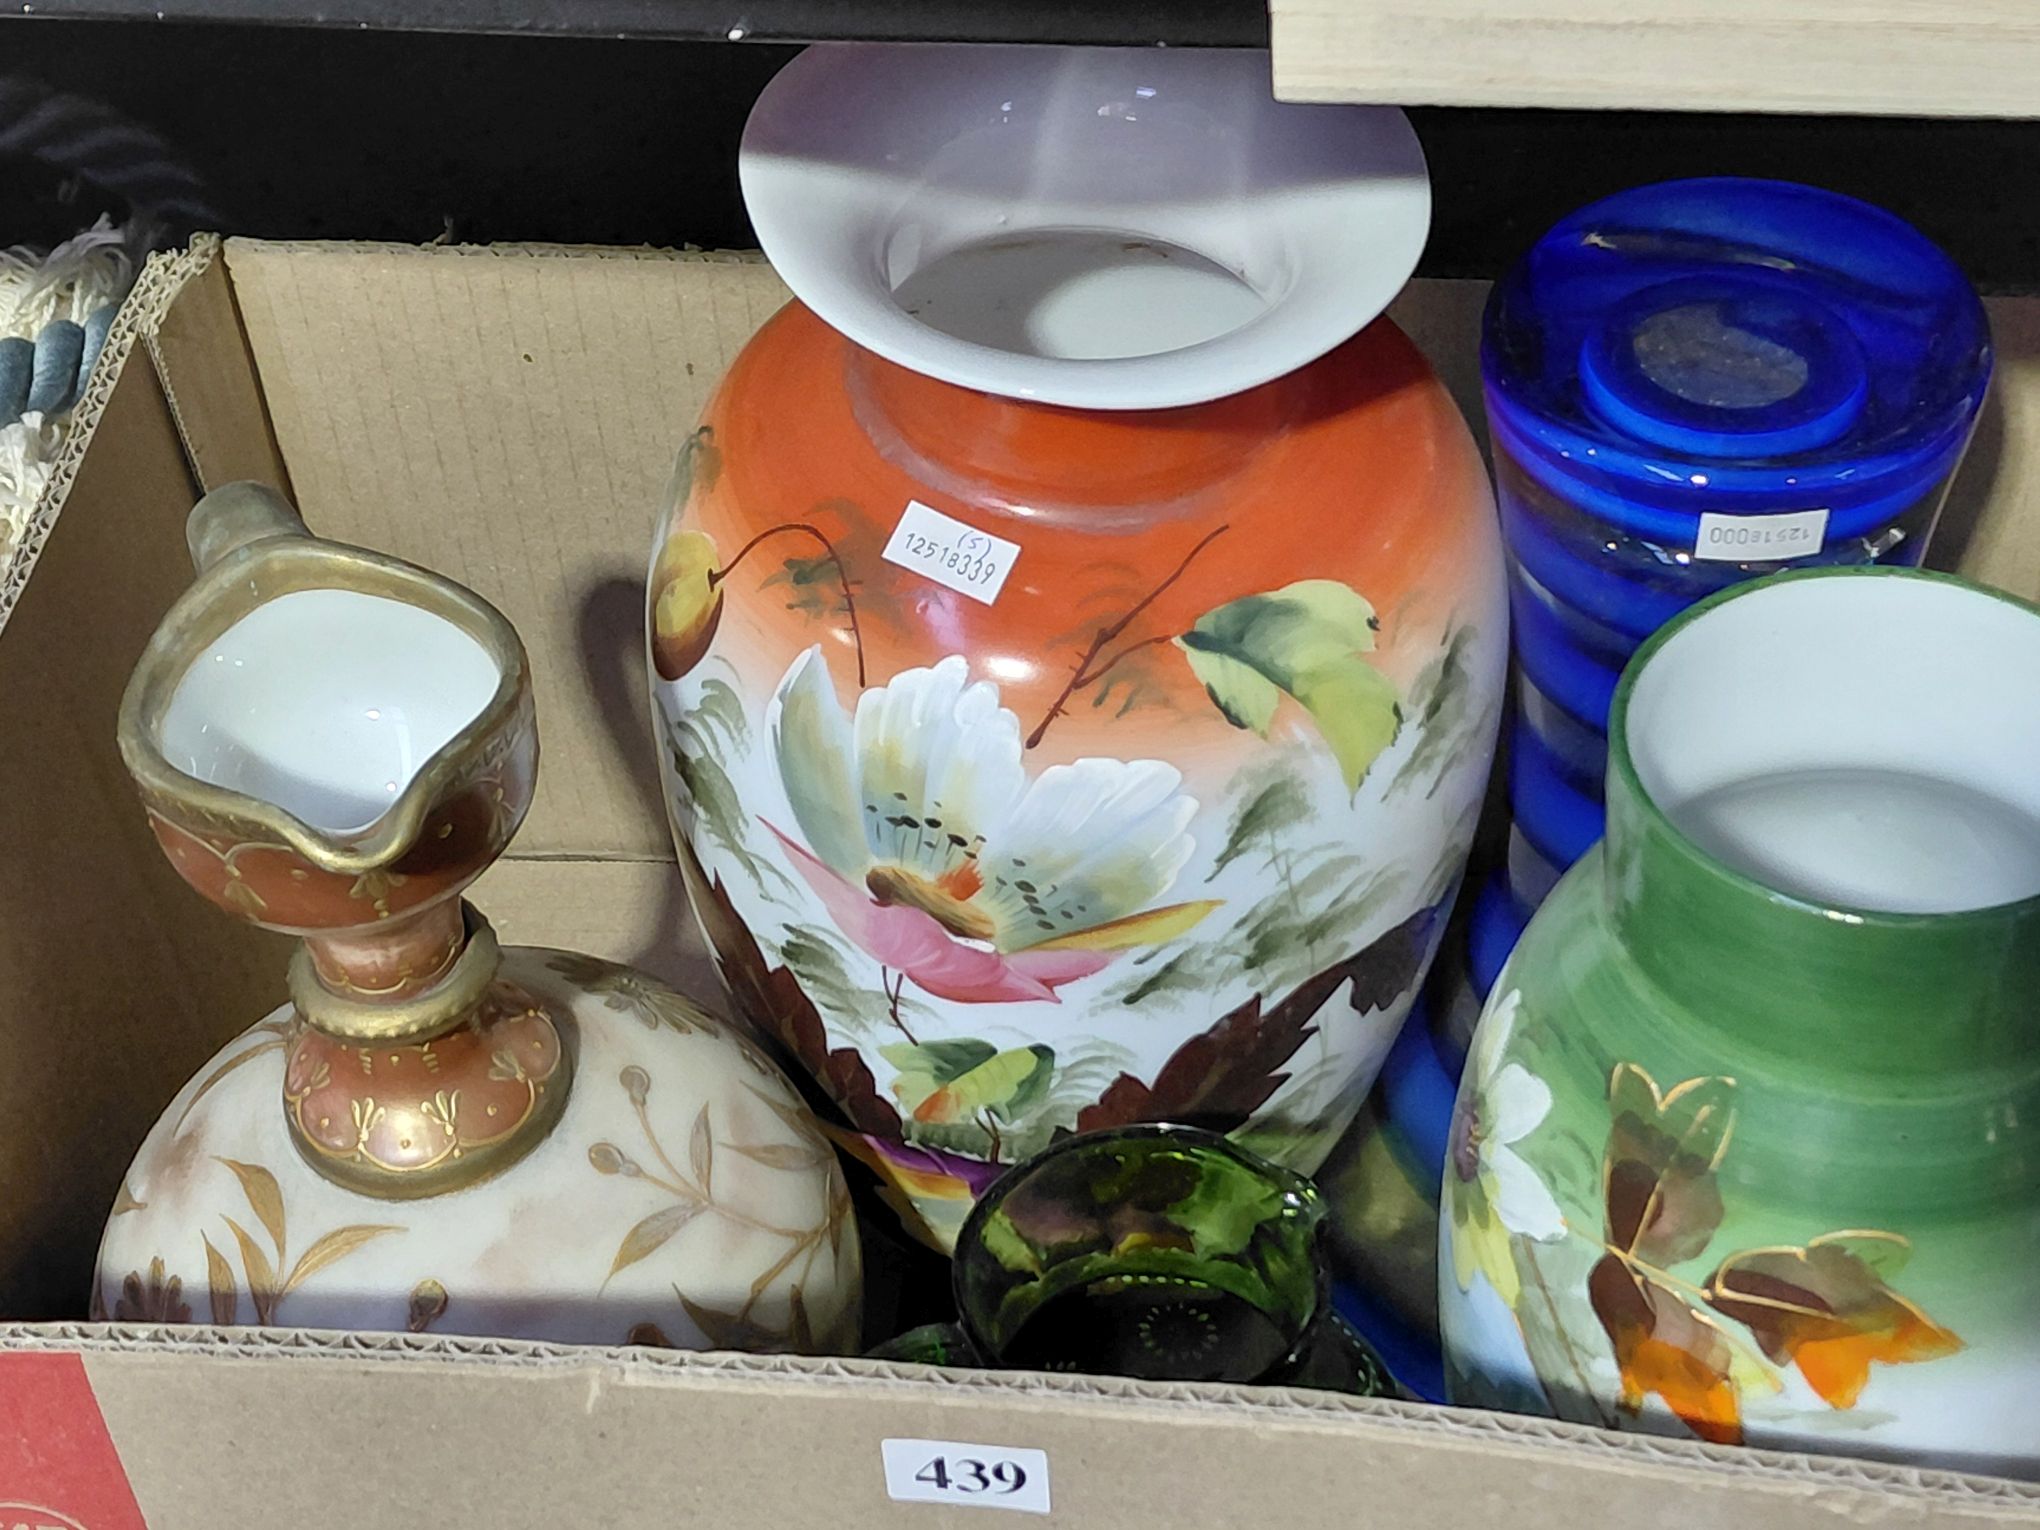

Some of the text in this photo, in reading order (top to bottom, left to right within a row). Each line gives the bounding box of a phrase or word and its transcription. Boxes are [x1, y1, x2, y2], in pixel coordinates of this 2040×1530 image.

[1709, 526, 1810, 545] 12518000
[905, 532, 996, 585] 12518339
[915, 1455, 1027, 1495] 439
